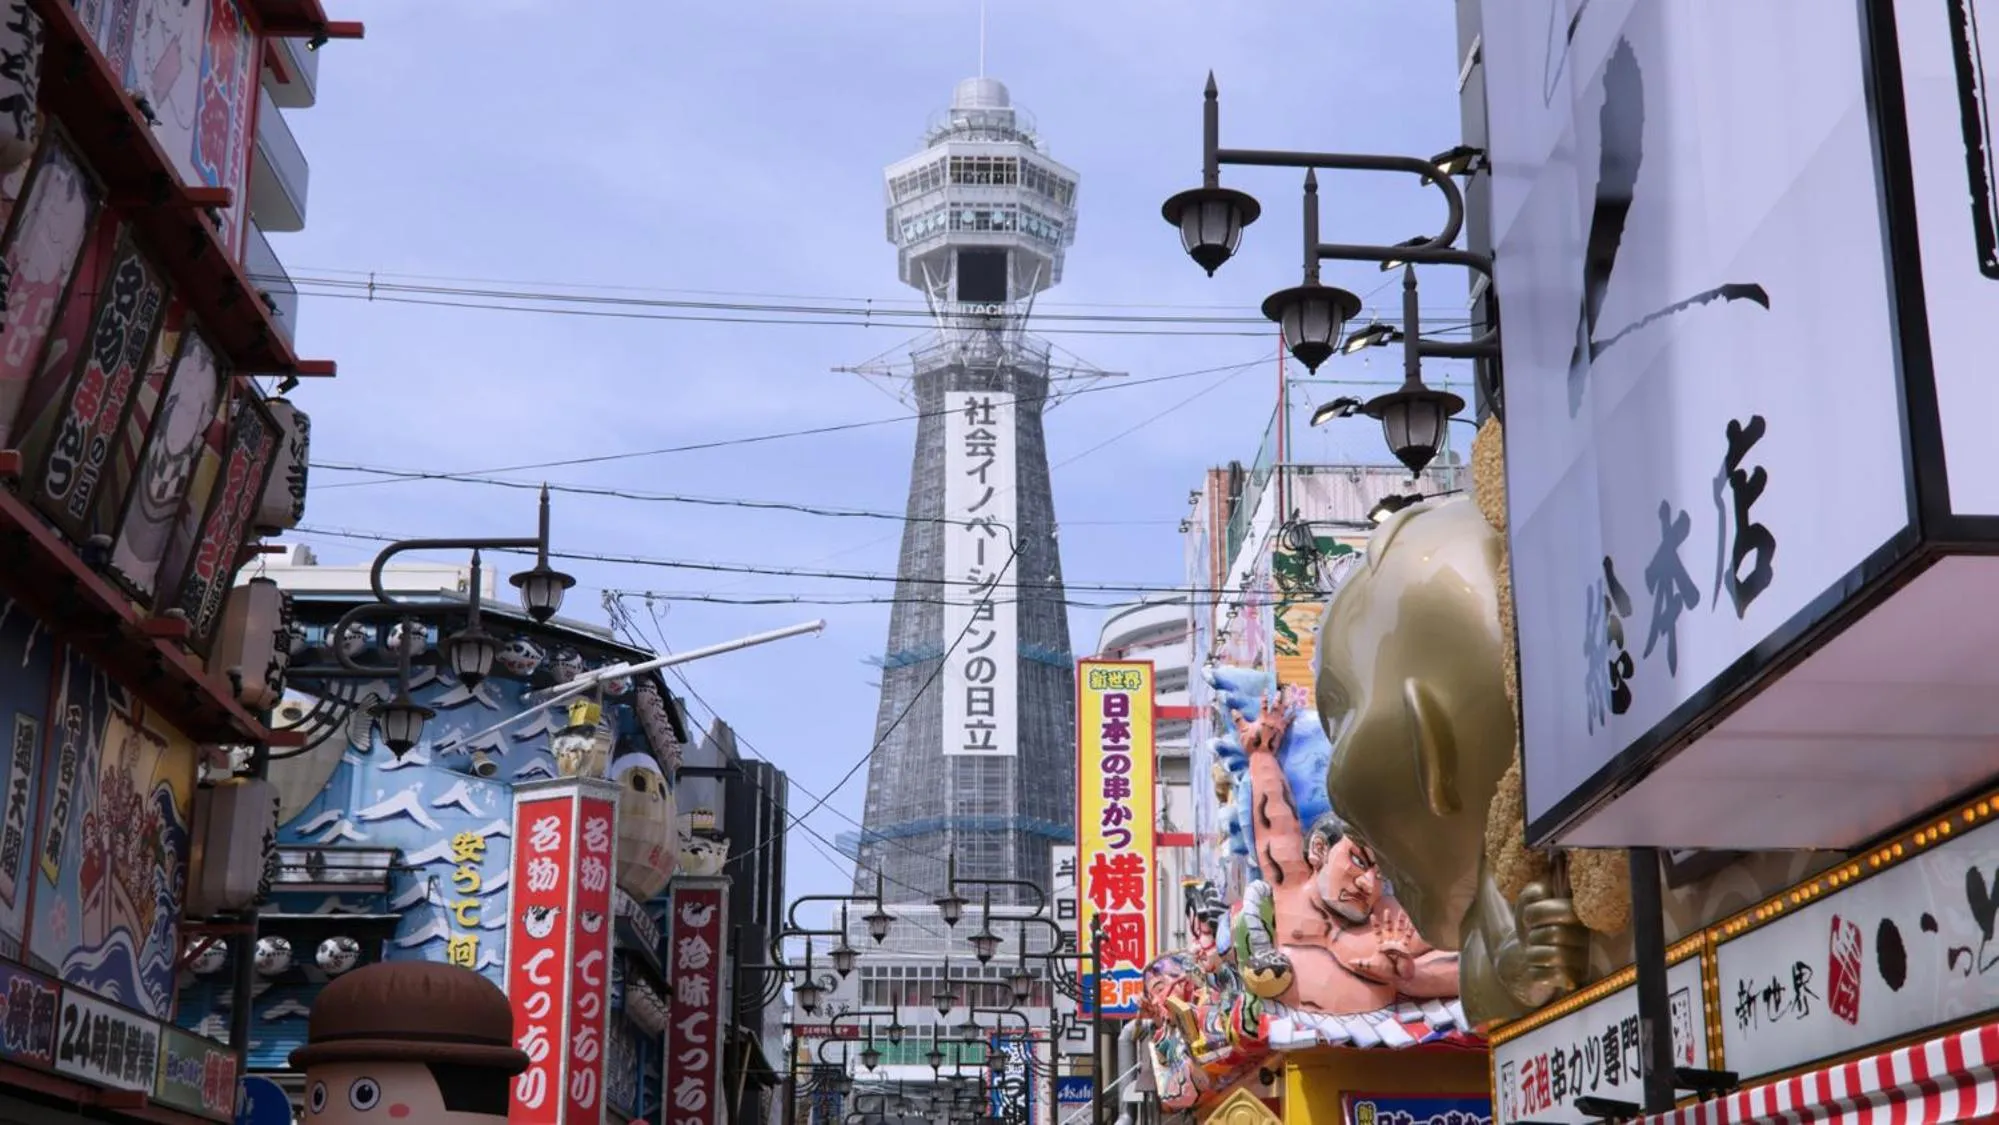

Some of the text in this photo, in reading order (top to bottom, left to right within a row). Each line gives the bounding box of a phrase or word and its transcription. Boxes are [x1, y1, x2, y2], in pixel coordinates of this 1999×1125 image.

[962, 396, 998, 751] 社会イノベーションの日立
[1582, 414, 1777, 736] 総本店
[1089, 670, 1142, 690] 新世界
[1101, 693, 1132, 850] 日本一の串かつ
[515, 815, 561, 1109] 名物 てっちり
[571, 815, 610, 1110] 名物 てっちり
[1088, 852, 1146, 970] 横綱
[60, 1003, 157, 1085] 24時間営業
[1520, 1014, 1641, 1115] 元祖串カツ専門
[1735, 960, 1821, 1040] 新世界
